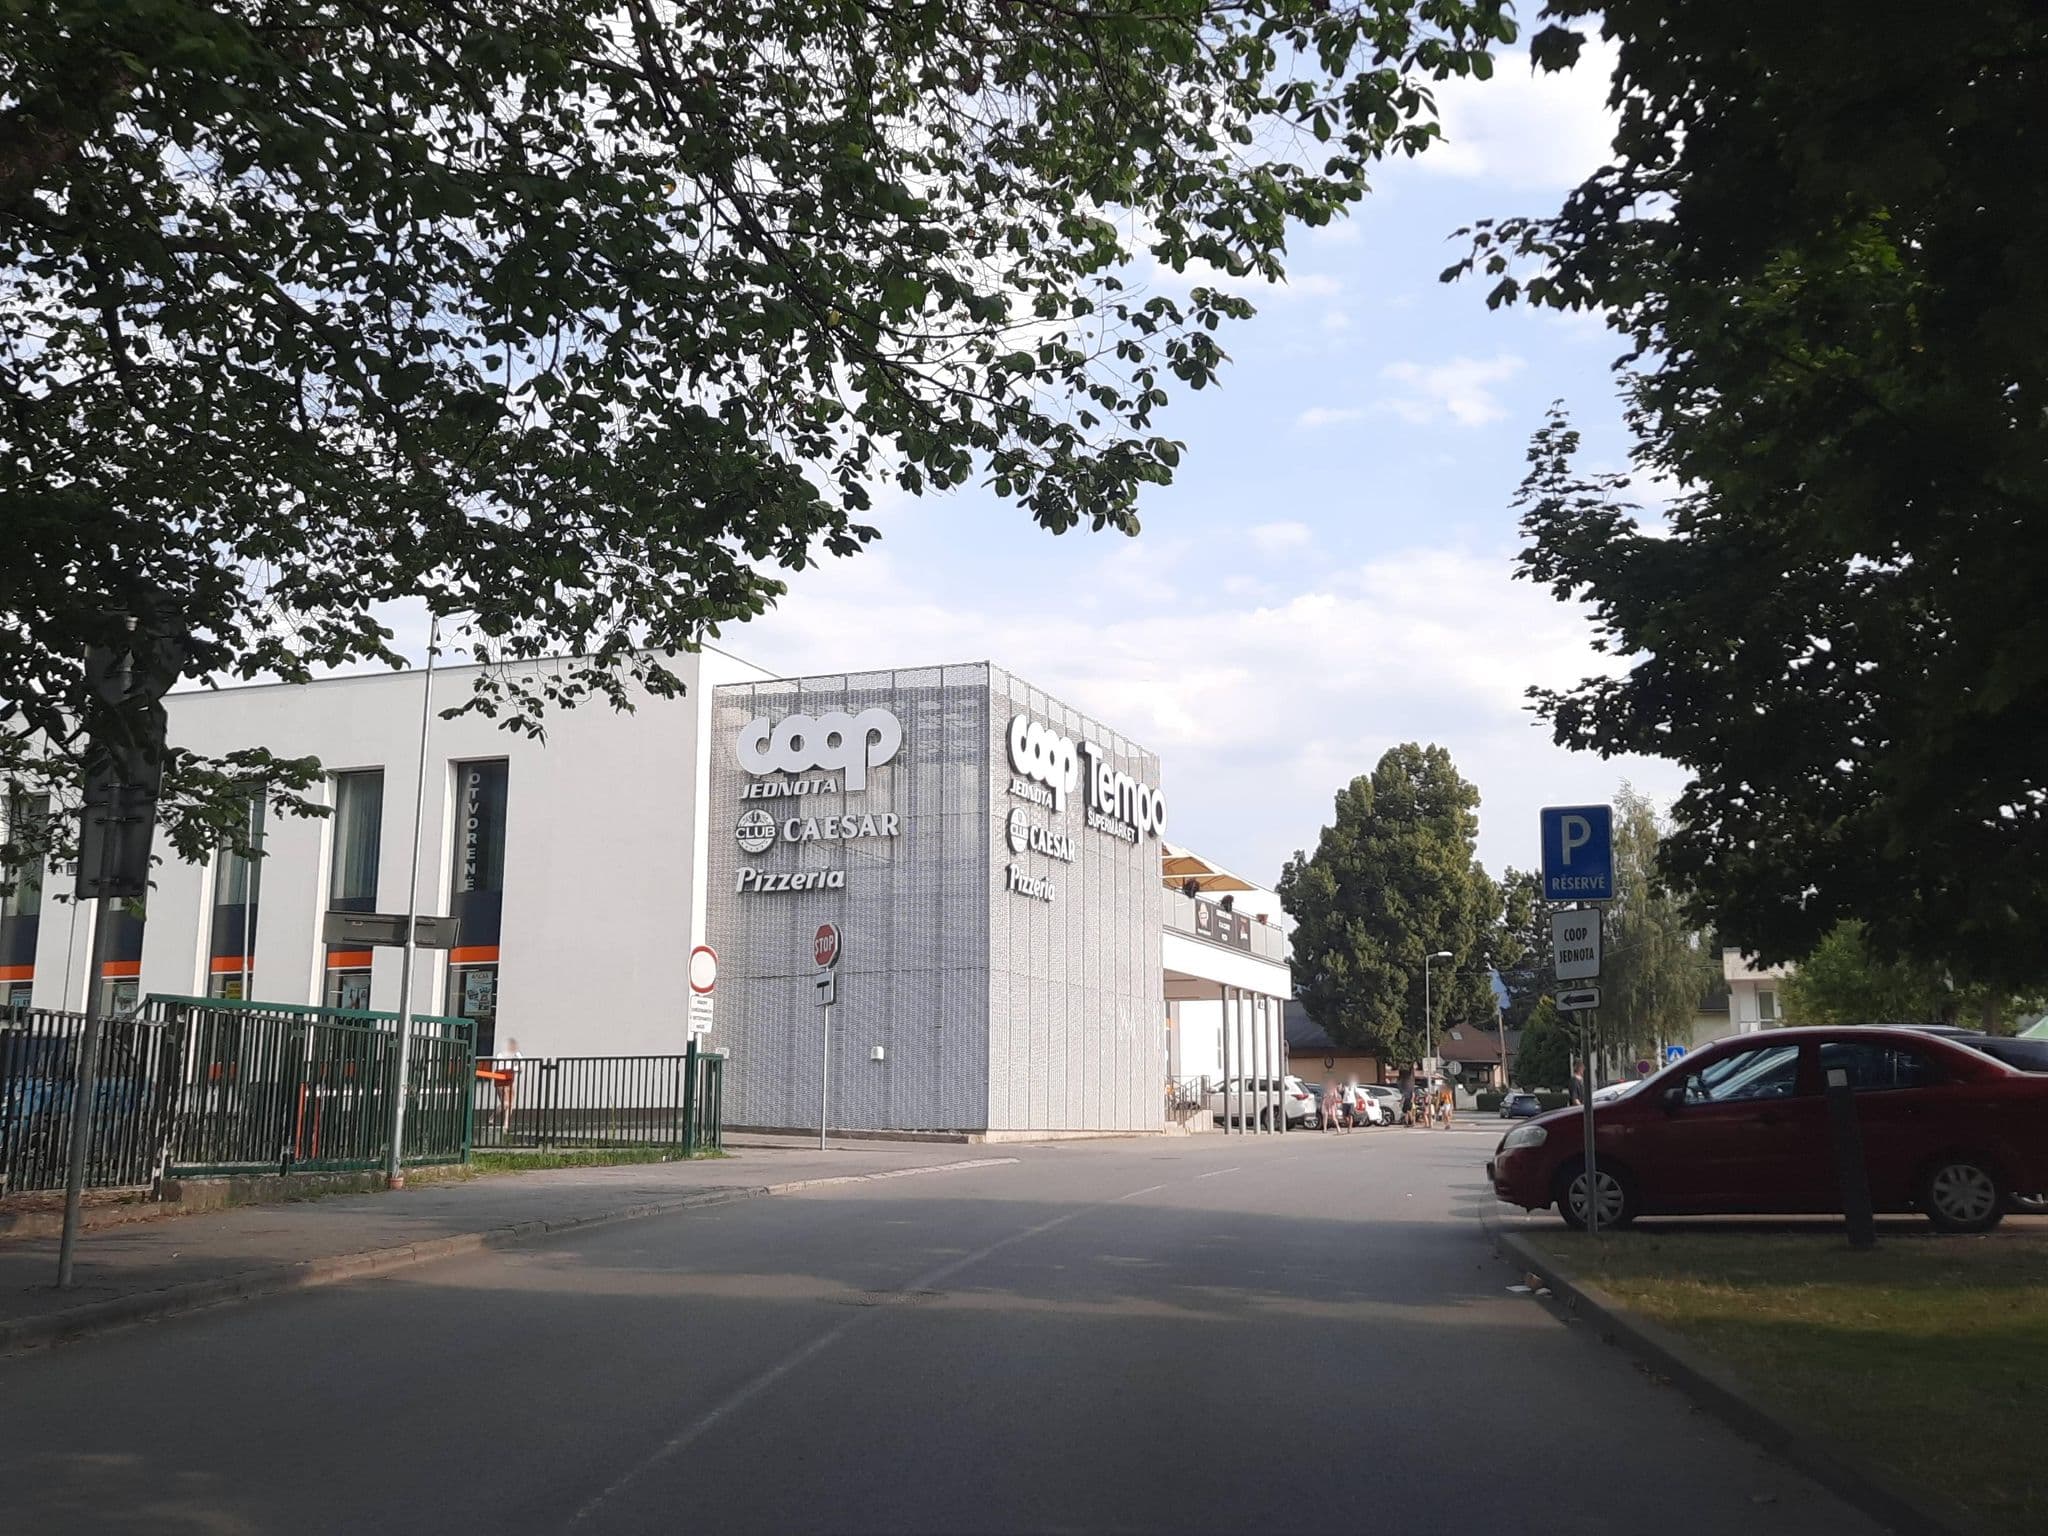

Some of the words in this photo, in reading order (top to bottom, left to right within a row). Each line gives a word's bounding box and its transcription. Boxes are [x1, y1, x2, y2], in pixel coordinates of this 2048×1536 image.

[736, 708, 902, 791] coop
[1010, 714, 1078, 812] coop
[741, 779, 839, 800] JEDNOTA
[1010, 778, 1053, 809] JEDNOTA
[1083, 741, 1167, 844] Tempo
[735, 826, 776, 839] CLUB
[783, 813, 900, 842] CAESAR
[1087, 809, 1136, 843] SUPERMARKET
[1561, 815, 1592, 865] P
[1029, 825, 1076, 862] CAESAR
[735, 866, 846, 893] Pizzeria
[1010, 863, 1056, 901] Pizzeria
[815, 935, 834, 954] STOP
[1563, 927, 1588, 942] COOP
[1559, 947, 1595, 964] JEDNOTA
